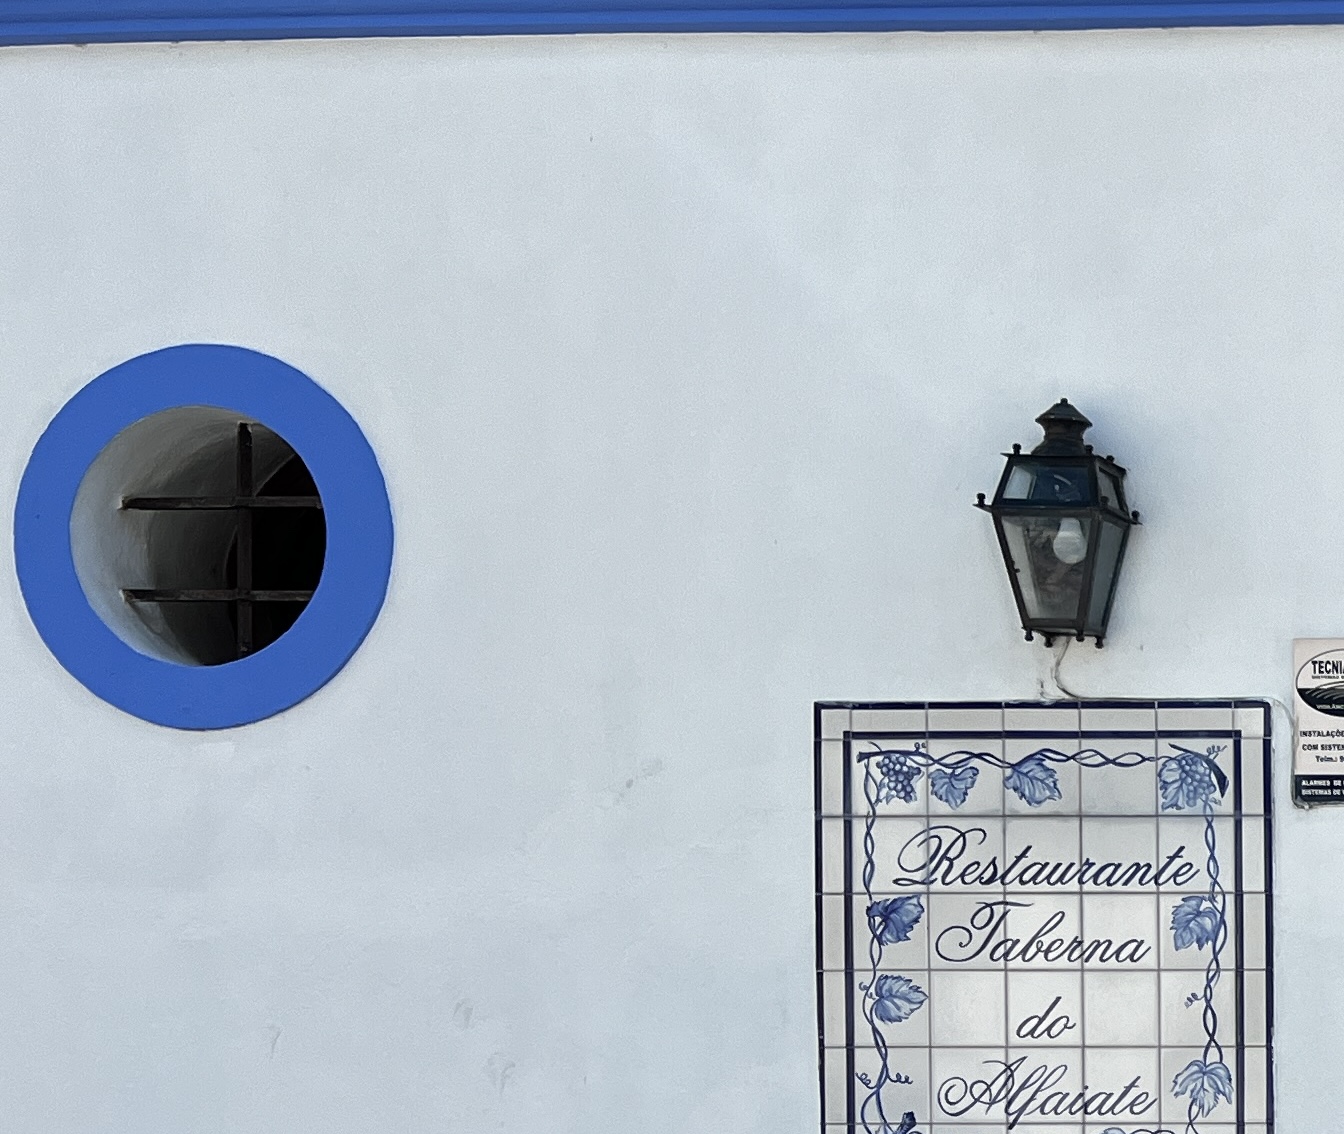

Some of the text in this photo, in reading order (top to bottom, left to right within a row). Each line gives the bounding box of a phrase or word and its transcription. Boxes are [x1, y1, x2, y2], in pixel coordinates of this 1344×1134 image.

[891, 825, 1200, 887] Restaurante
[935, 900, 1152, 964] Taberna
[1015, 996, 1076, 1040] do
[937, 1055, 1159, 1131] Alfaiate
